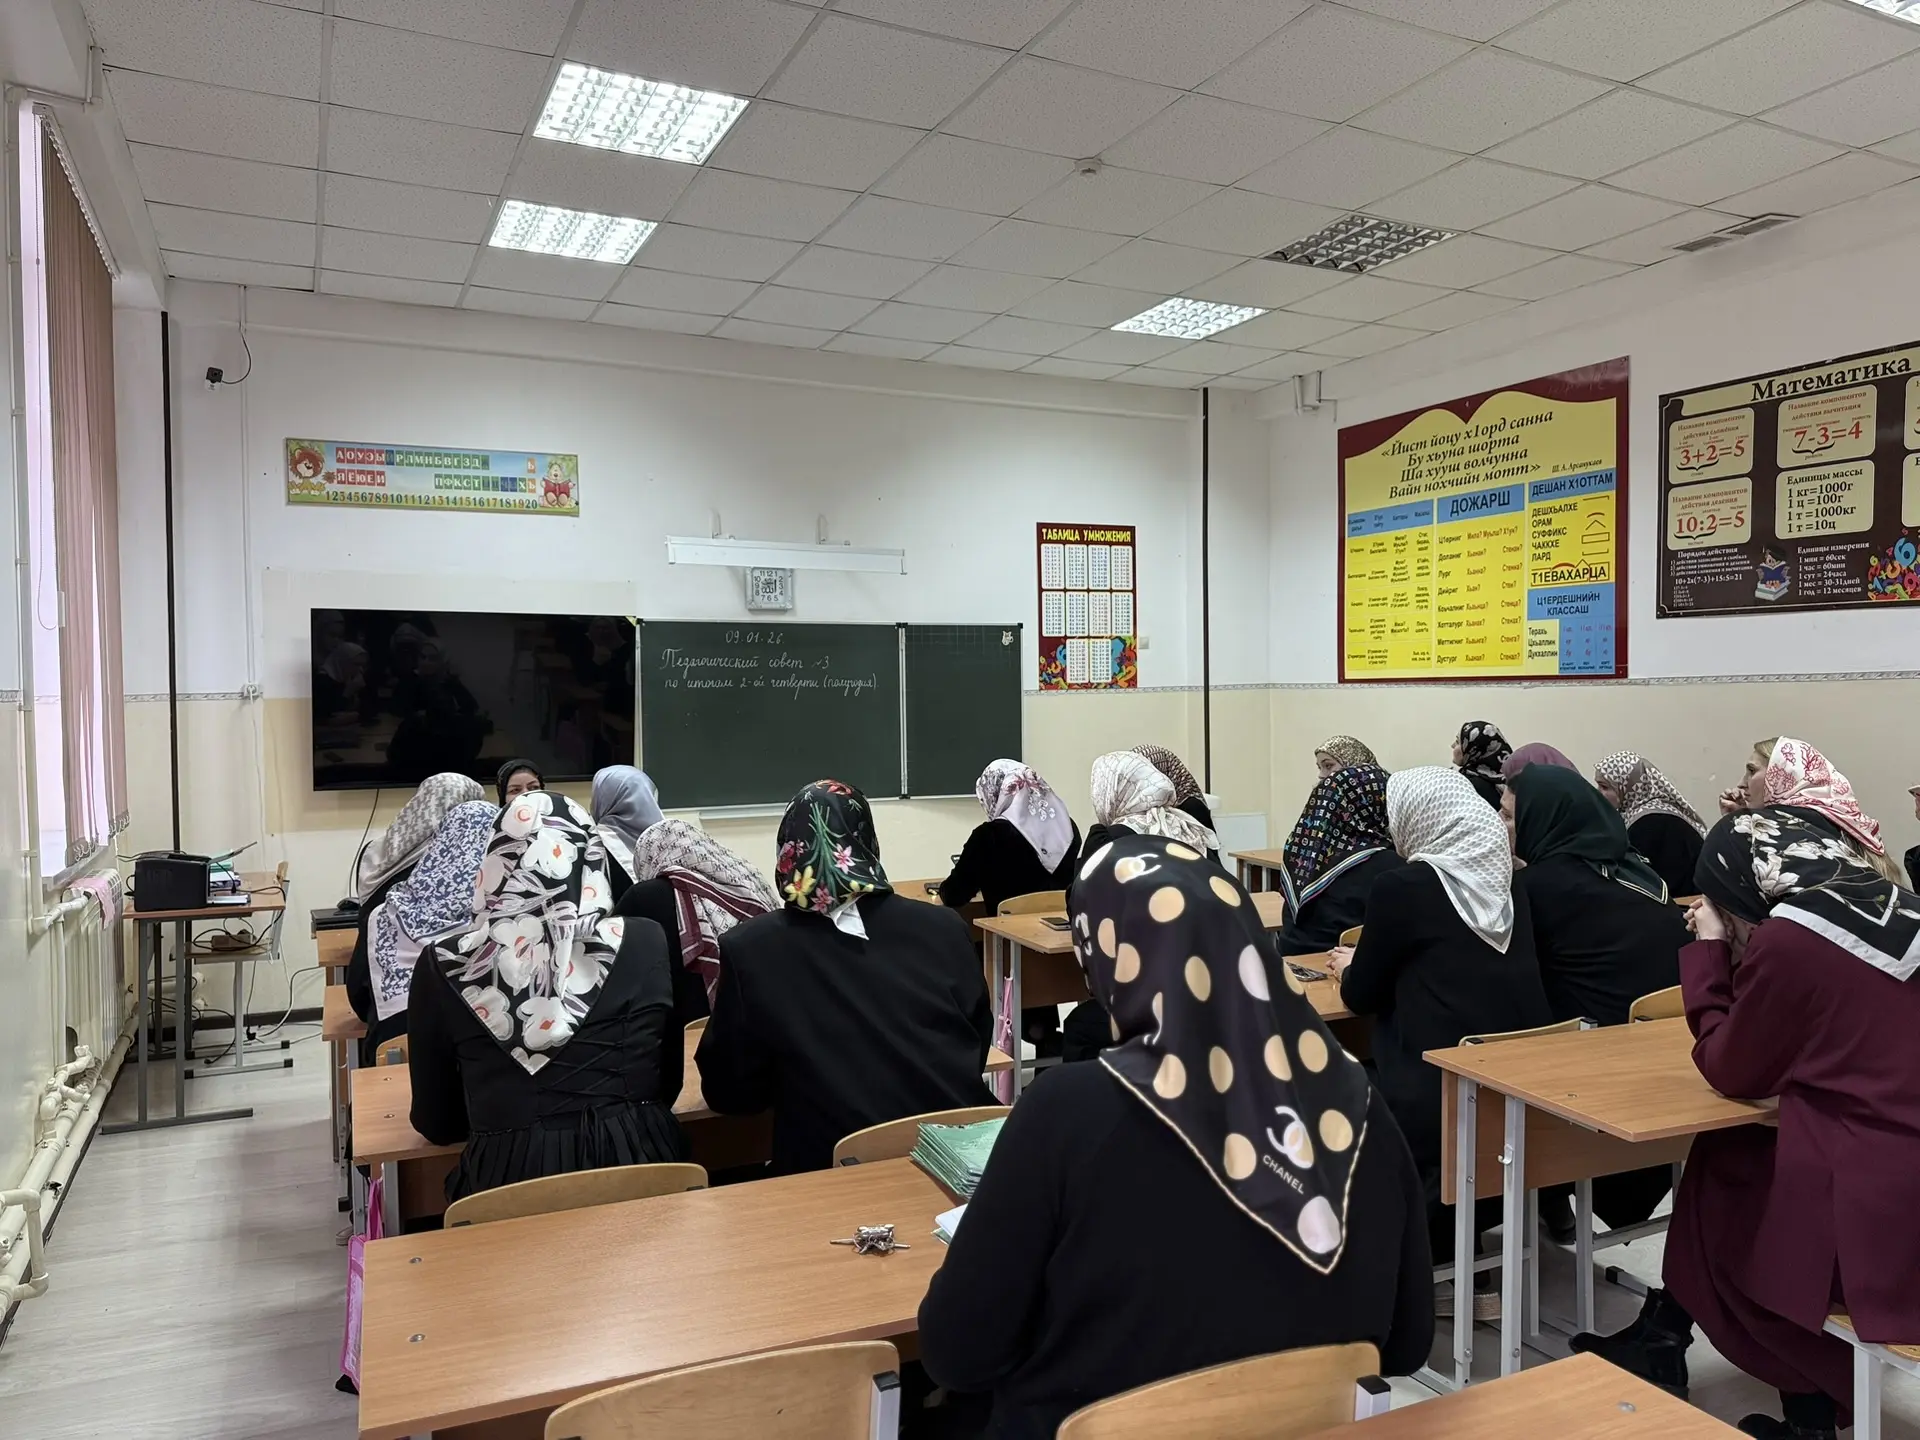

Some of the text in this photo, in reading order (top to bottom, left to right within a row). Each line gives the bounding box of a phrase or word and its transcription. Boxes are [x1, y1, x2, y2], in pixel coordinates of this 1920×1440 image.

[1751, 357, 1911, 401] Математика
[1381, 440, 1427, 457] «Йист
[1430, 431, 1461, 448] йоцу
[1509, 411, 1554, 429] санна
[1407, 433, 1521, 469] Бу хьуна шорта
[1680, 440, 1745, 466] 3+2=5
[1400, 448, 1528, 483] Ша хууш волчунна
[1389, 463, 1542, 499] Вайн нохчийн мотт»
[1787, 468, 1863, 486] Единицы массы
[1531, 481, 1566, 497] ДЕШАН
[1450, 490, 1510, 517] ДОЖАРШ
[1532, 518, 1553, 528] ОРАМ
[1676, 510, 1745, 534] 10:2=5
[1041, 528, 1131, 543] ТАБЛИЦА УМНОЖЕНИЯ
[1532, 527, 1568, 539] СУФФИКС
[1532, 539, 1560, 550] ЧАККХЕ
[1797, 546, 1829, 554] Единицы
[1532, 552, 1551, 562] ЛАРД
[1547, 605, 1589, 616] КЛАССАШ
[768, 652, 804, 669] совет
[664, 678, 679, 688] по
[687, 677, 734, 688] итогам
[770, 673, 820, 700] четверти
[1262, 1154, 1305, 1195] CHANEL
